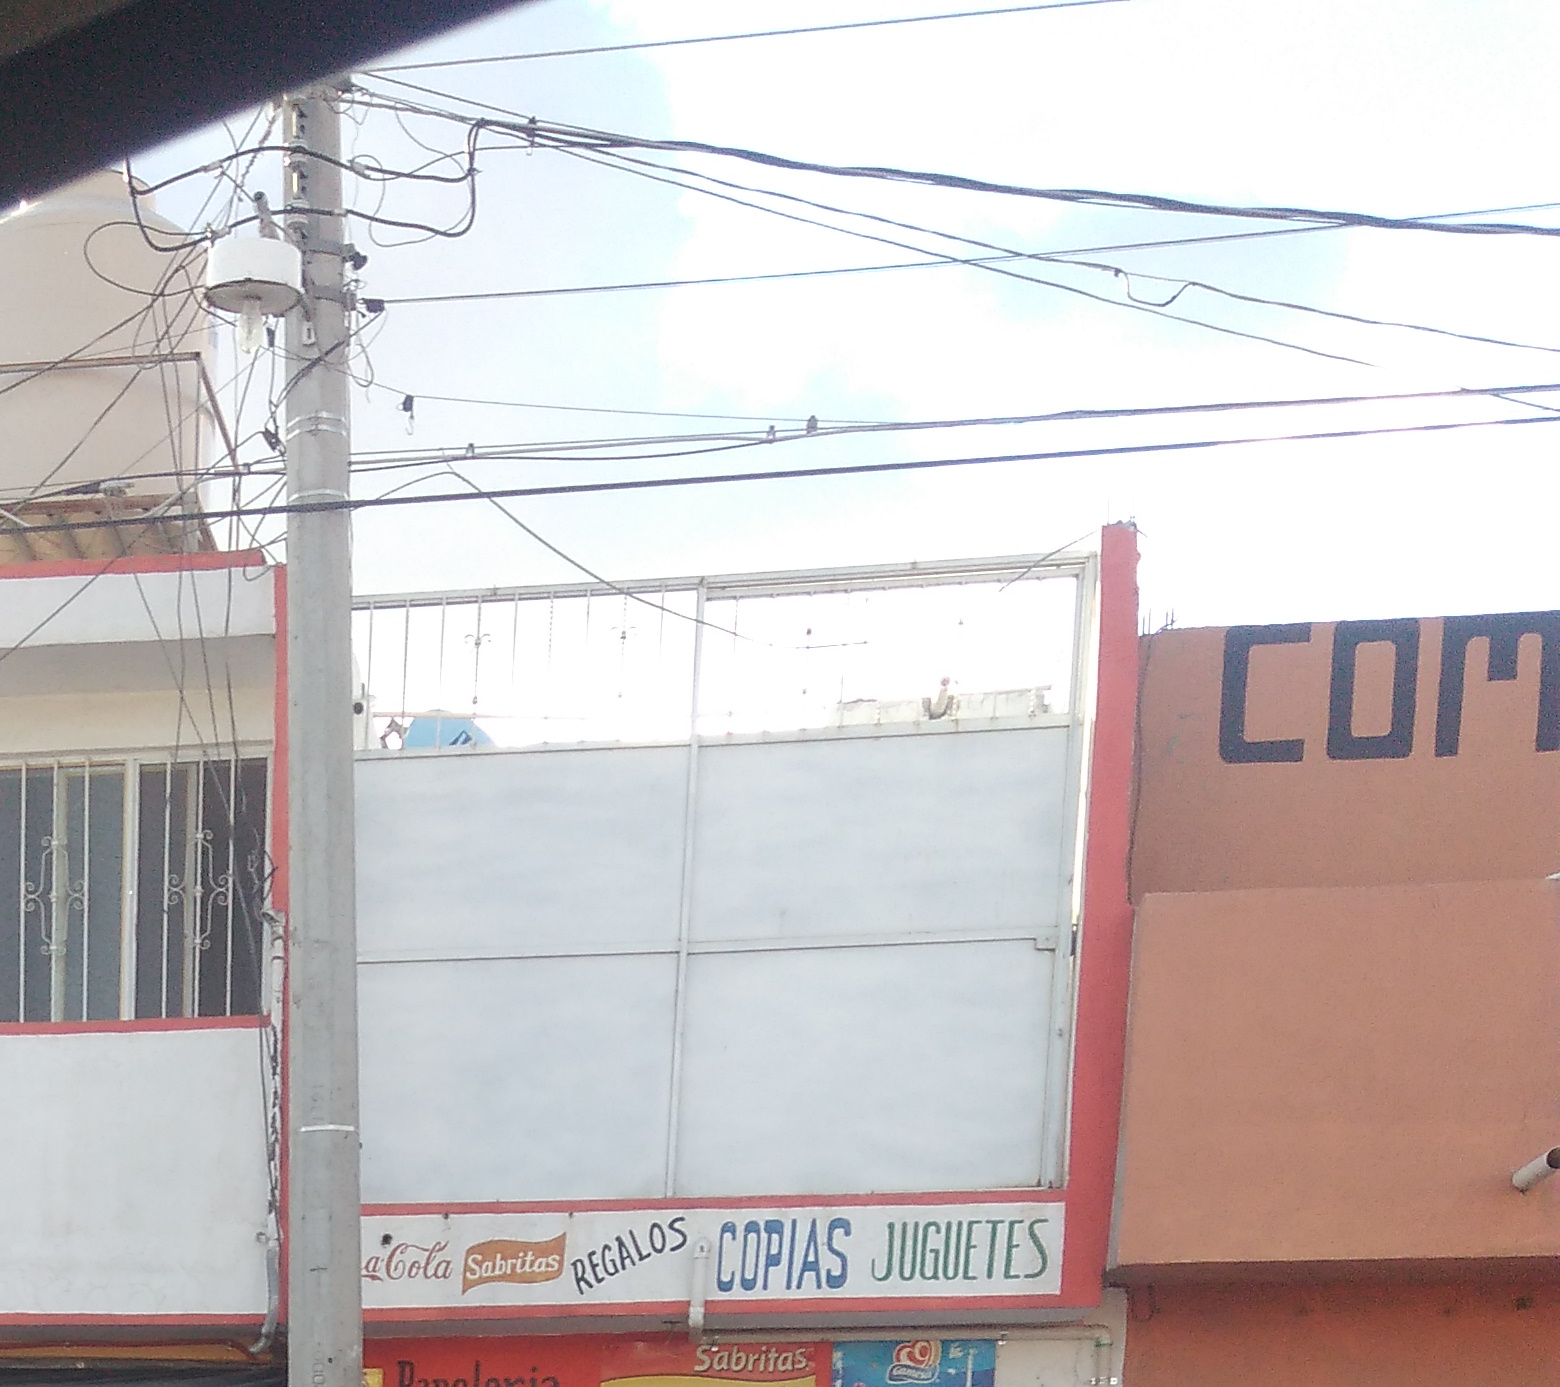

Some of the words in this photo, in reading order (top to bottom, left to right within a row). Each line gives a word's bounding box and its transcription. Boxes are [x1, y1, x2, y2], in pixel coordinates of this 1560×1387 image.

[466, 1251, 561, 1281] Sabritas
[570, 1215, 688, 1296] REGALOS
[716, 1216, 852, 1293] COPIAS
[870, 1217, 1050, 1283] JUGUETES
[693, 1343, 809, 1374] Sabritas
